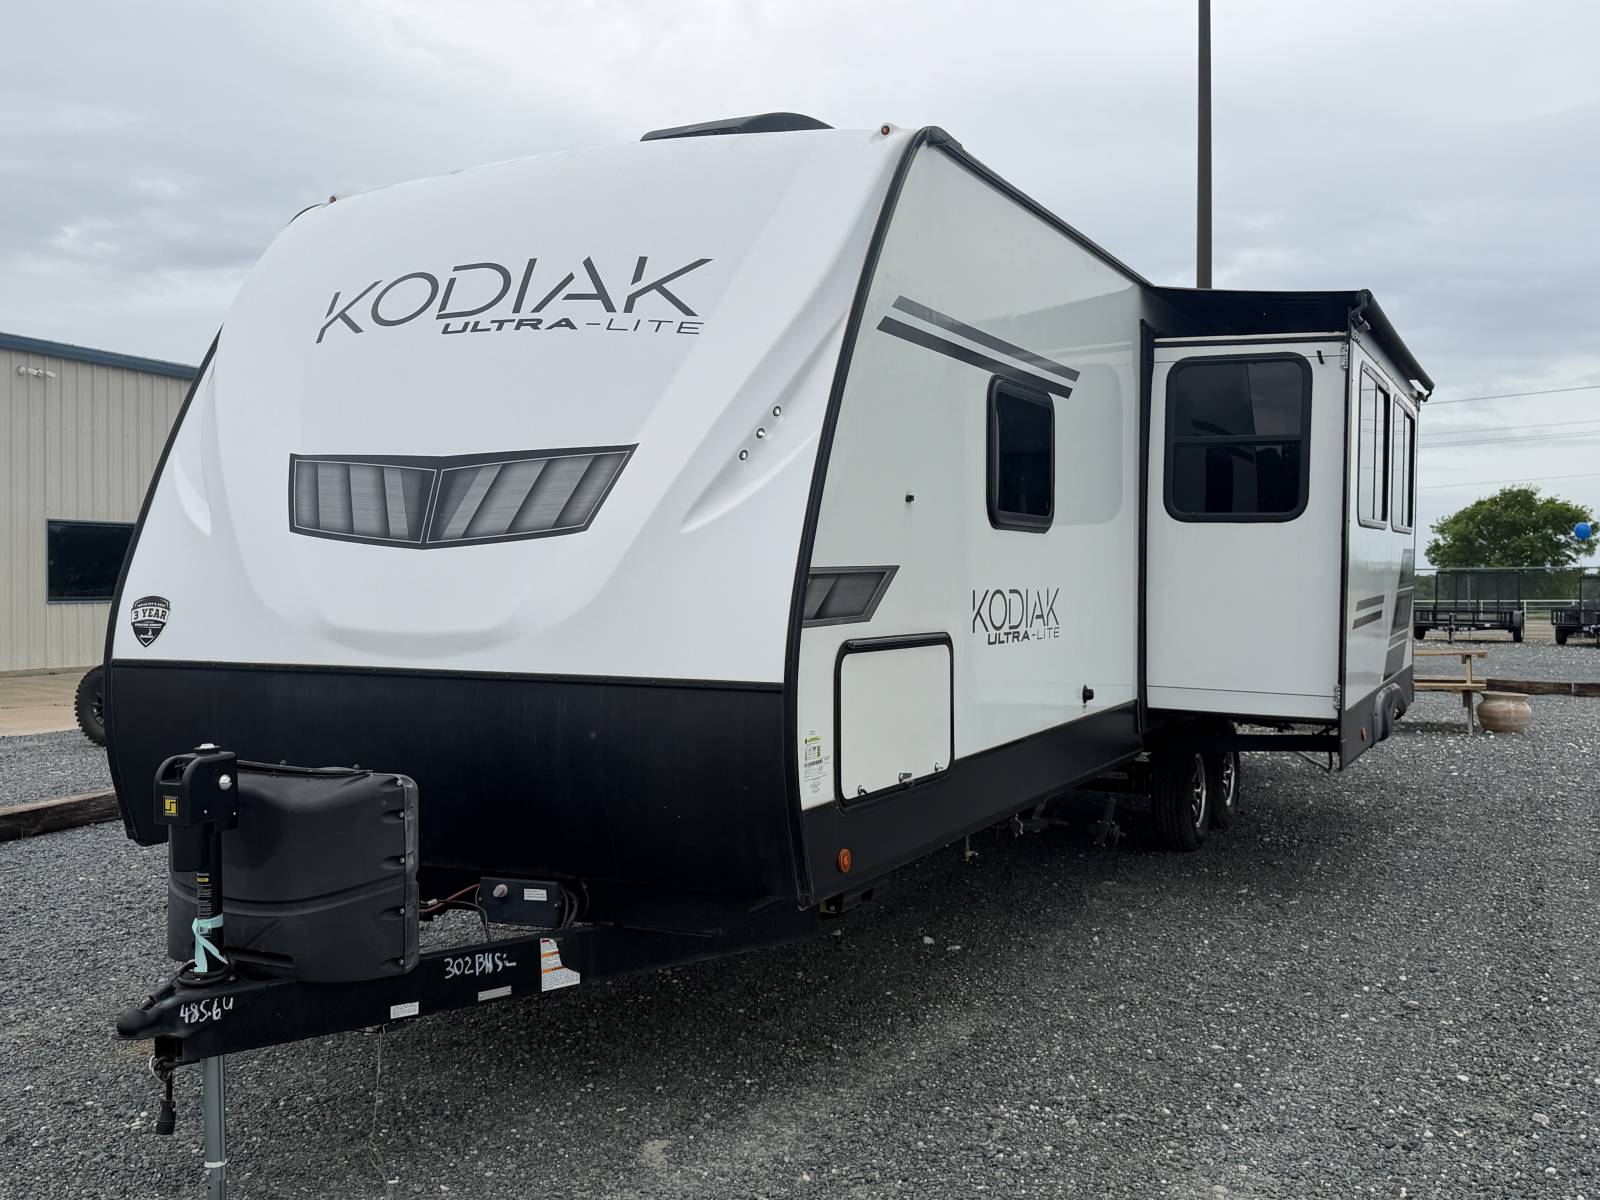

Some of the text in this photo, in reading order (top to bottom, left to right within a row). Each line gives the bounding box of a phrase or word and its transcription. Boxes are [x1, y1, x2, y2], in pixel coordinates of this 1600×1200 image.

[316, 255, 714, 344] KODIAK
[441, 316, 705, 335] ULTRA-LITE
[133, 608, 167, 620] 3 YEAR
[972, 588, 1060, 633] KODIAK
[987, 626, 1060, 645] ULTRA-LITE
